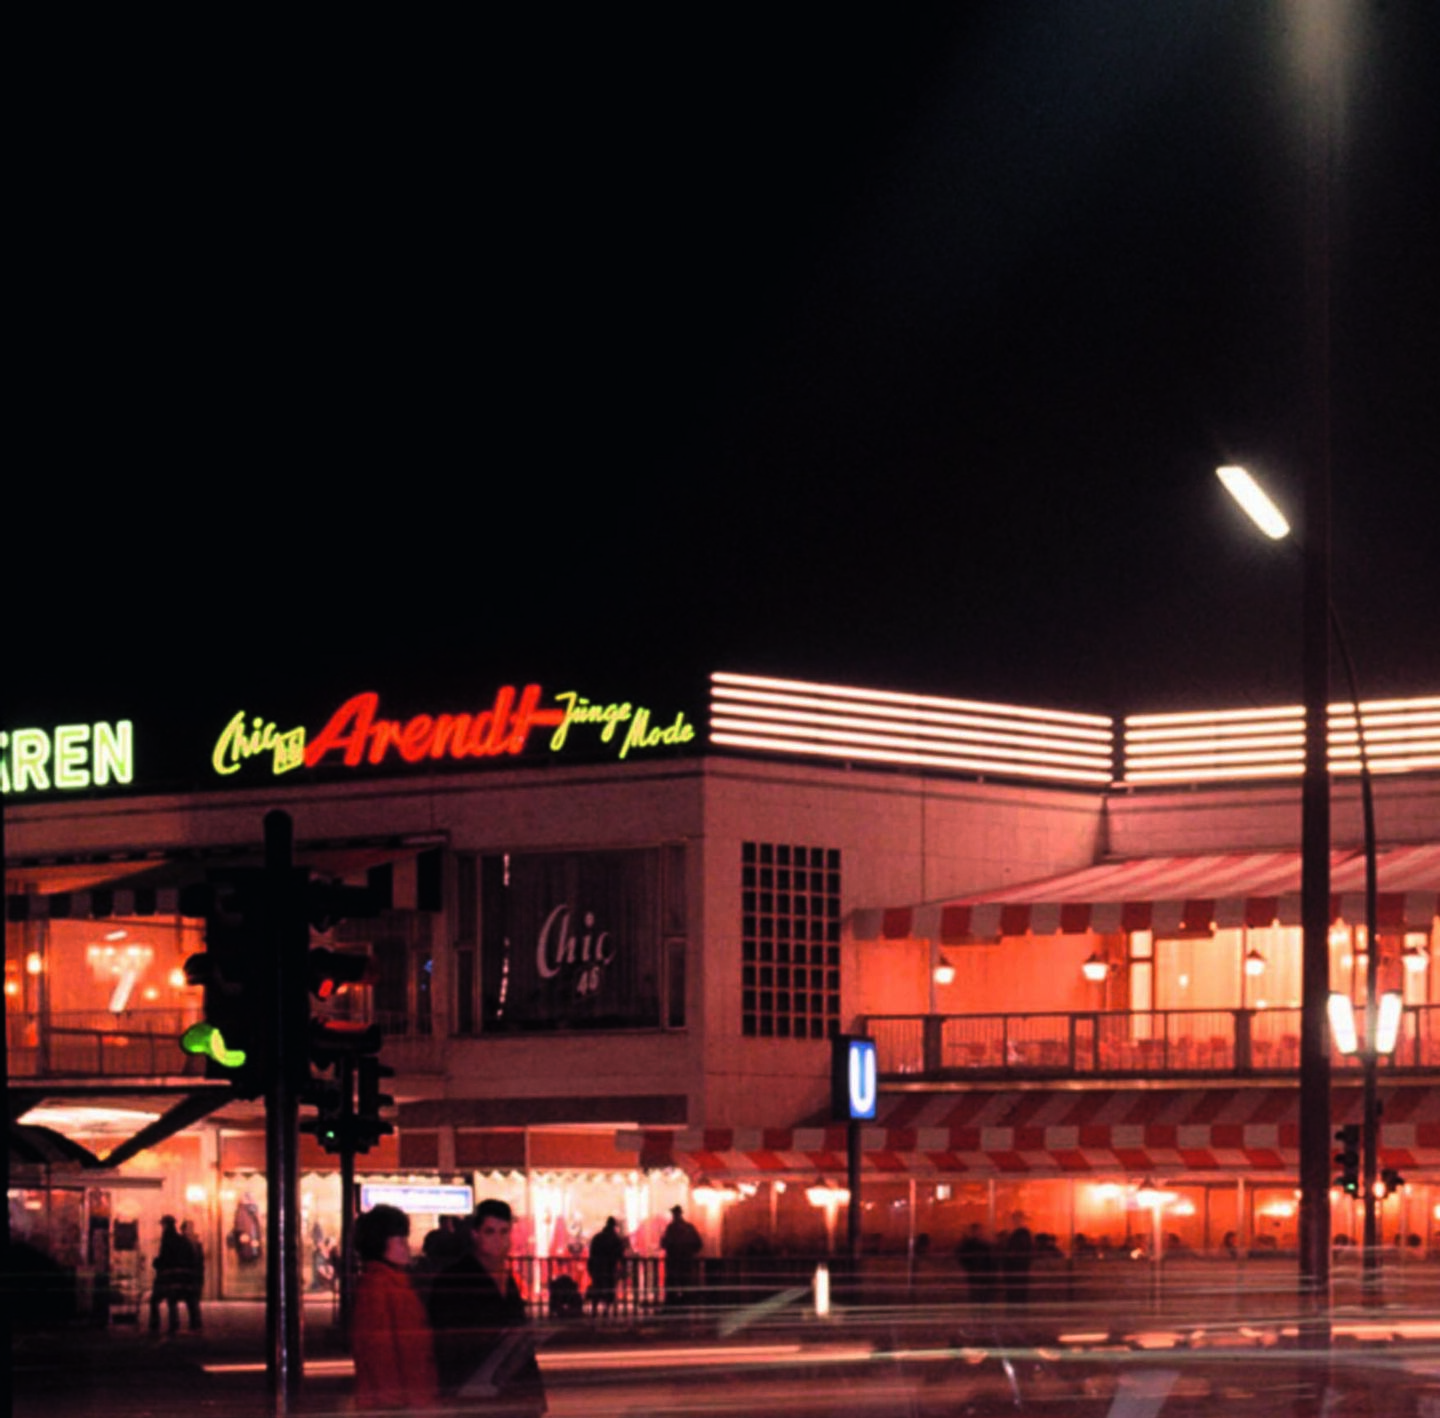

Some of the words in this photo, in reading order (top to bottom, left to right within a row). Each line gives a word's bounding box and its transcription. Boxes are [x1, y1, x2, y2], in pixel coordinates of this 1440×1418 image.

[0, 720, 133, 793] REN
[212, 710, 278, 775] Chic
[304, 684, 565, 768] Arendt
[618, 707, 695, 759] Mode
[537, 903, 617, 978] Chic
[848, 1046, 876, 1114] U
